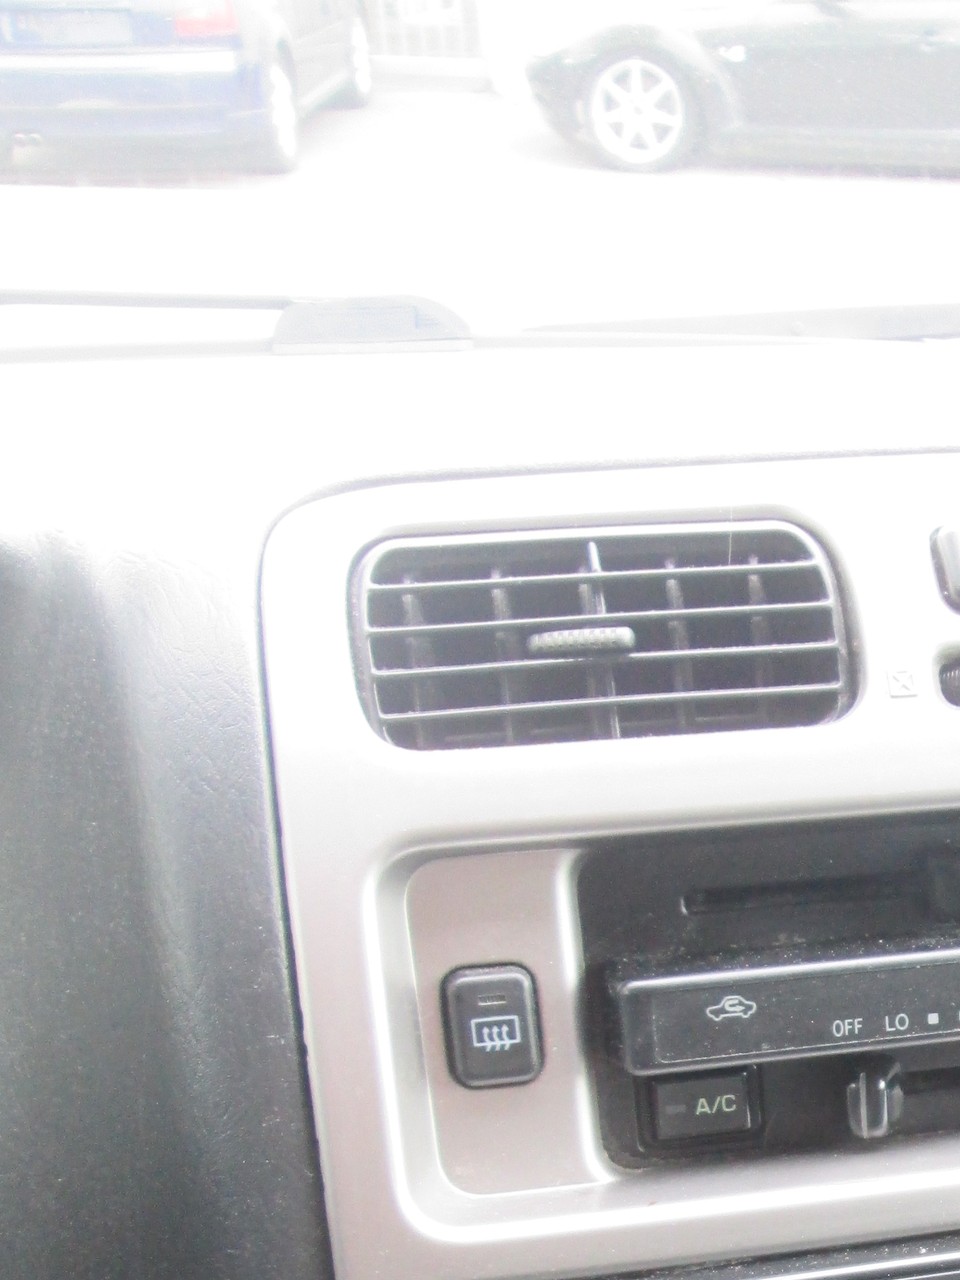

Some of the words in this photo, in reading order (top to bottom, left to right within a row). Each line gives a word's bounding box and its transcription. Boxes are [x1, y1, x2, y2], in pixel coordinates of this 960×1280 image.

[832, 1017, 863, 1037] OFF
[885, 1013, 909, 1031] LO
[695, 1094, 737, 1115] A/C
